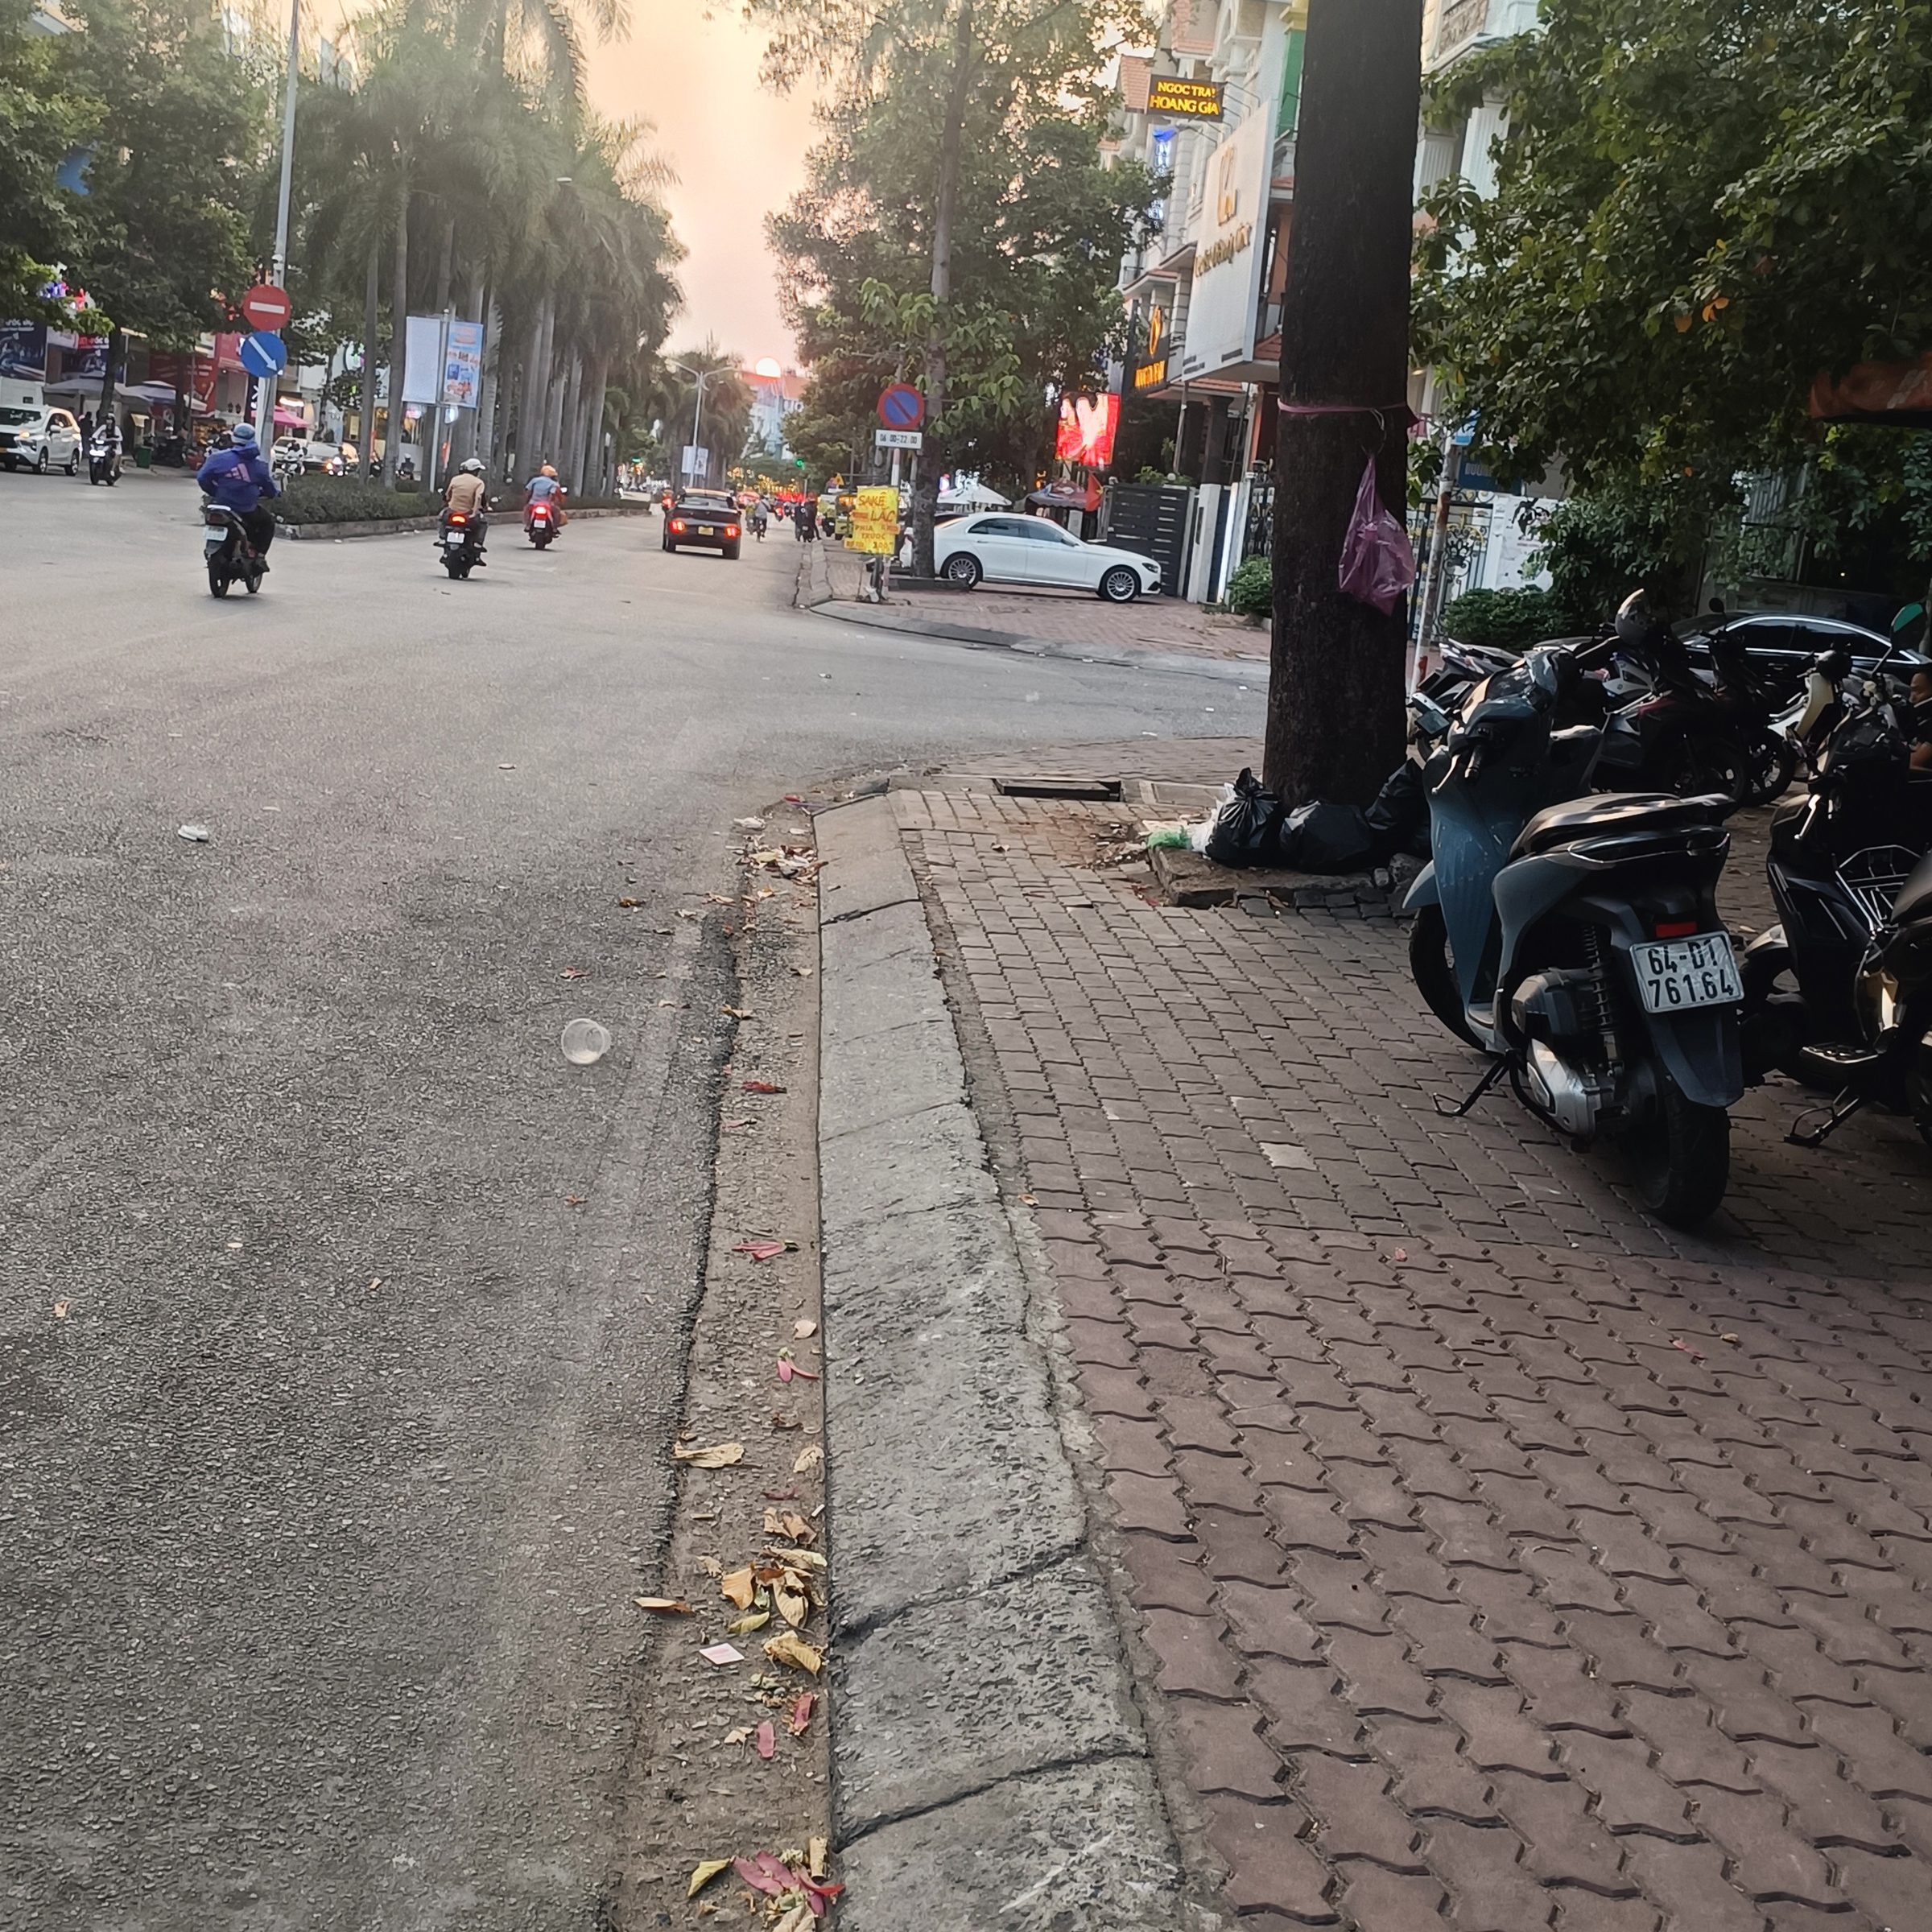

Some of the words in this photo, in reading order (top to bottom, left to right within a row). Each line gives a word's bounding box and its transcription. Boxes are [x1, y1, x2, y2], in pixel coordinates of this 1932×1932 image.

[1198, 101, 1219, 115] GIA
[1647, 939, 1718, 975] 64-D1
[1648, 968, 1734, 1008] 761.64
